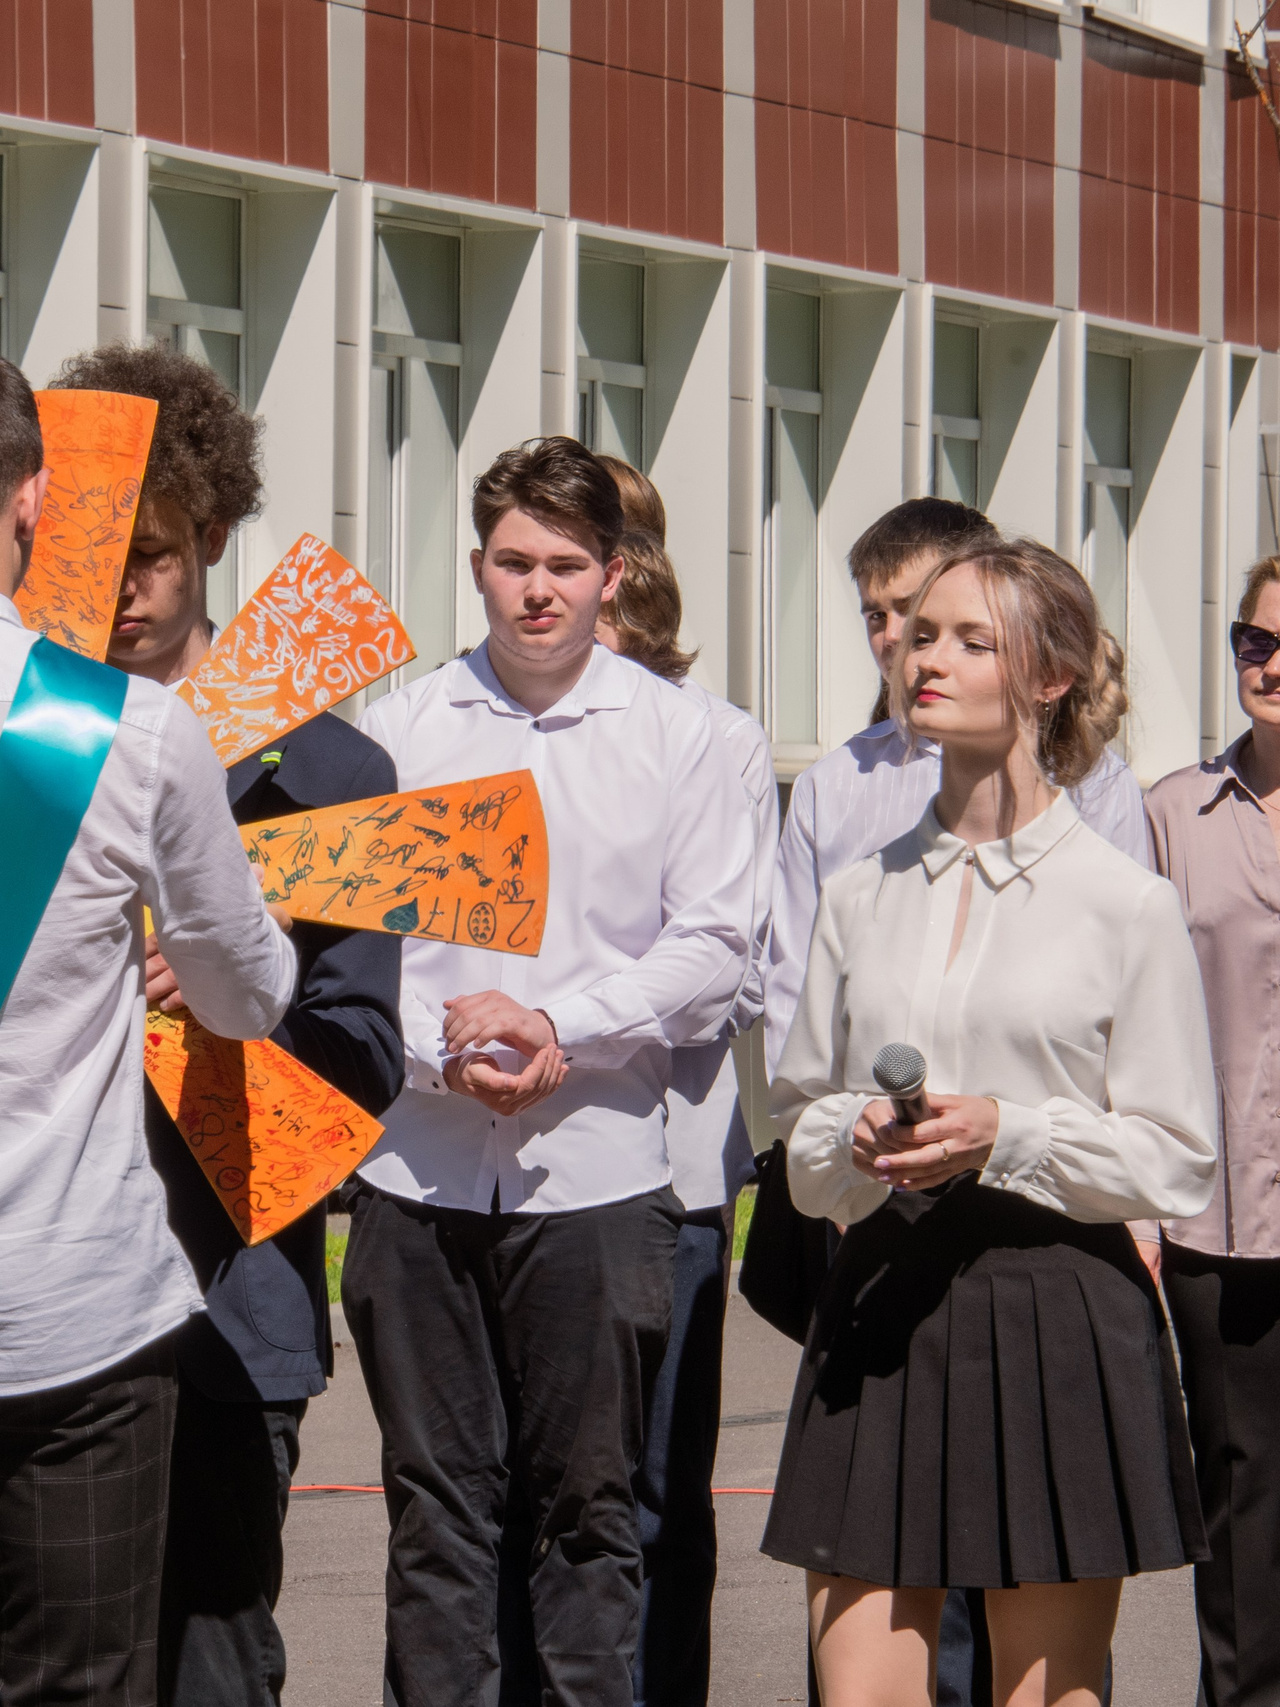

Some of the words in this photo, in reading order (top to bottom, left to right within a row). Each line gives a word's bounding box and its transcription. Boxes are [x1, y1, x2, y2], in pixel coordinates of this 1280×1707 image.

[324, 627, 408, 695] 2016
[418, 896, 536, 949] 2017
[189, 1112, 271, 1221] 2018
